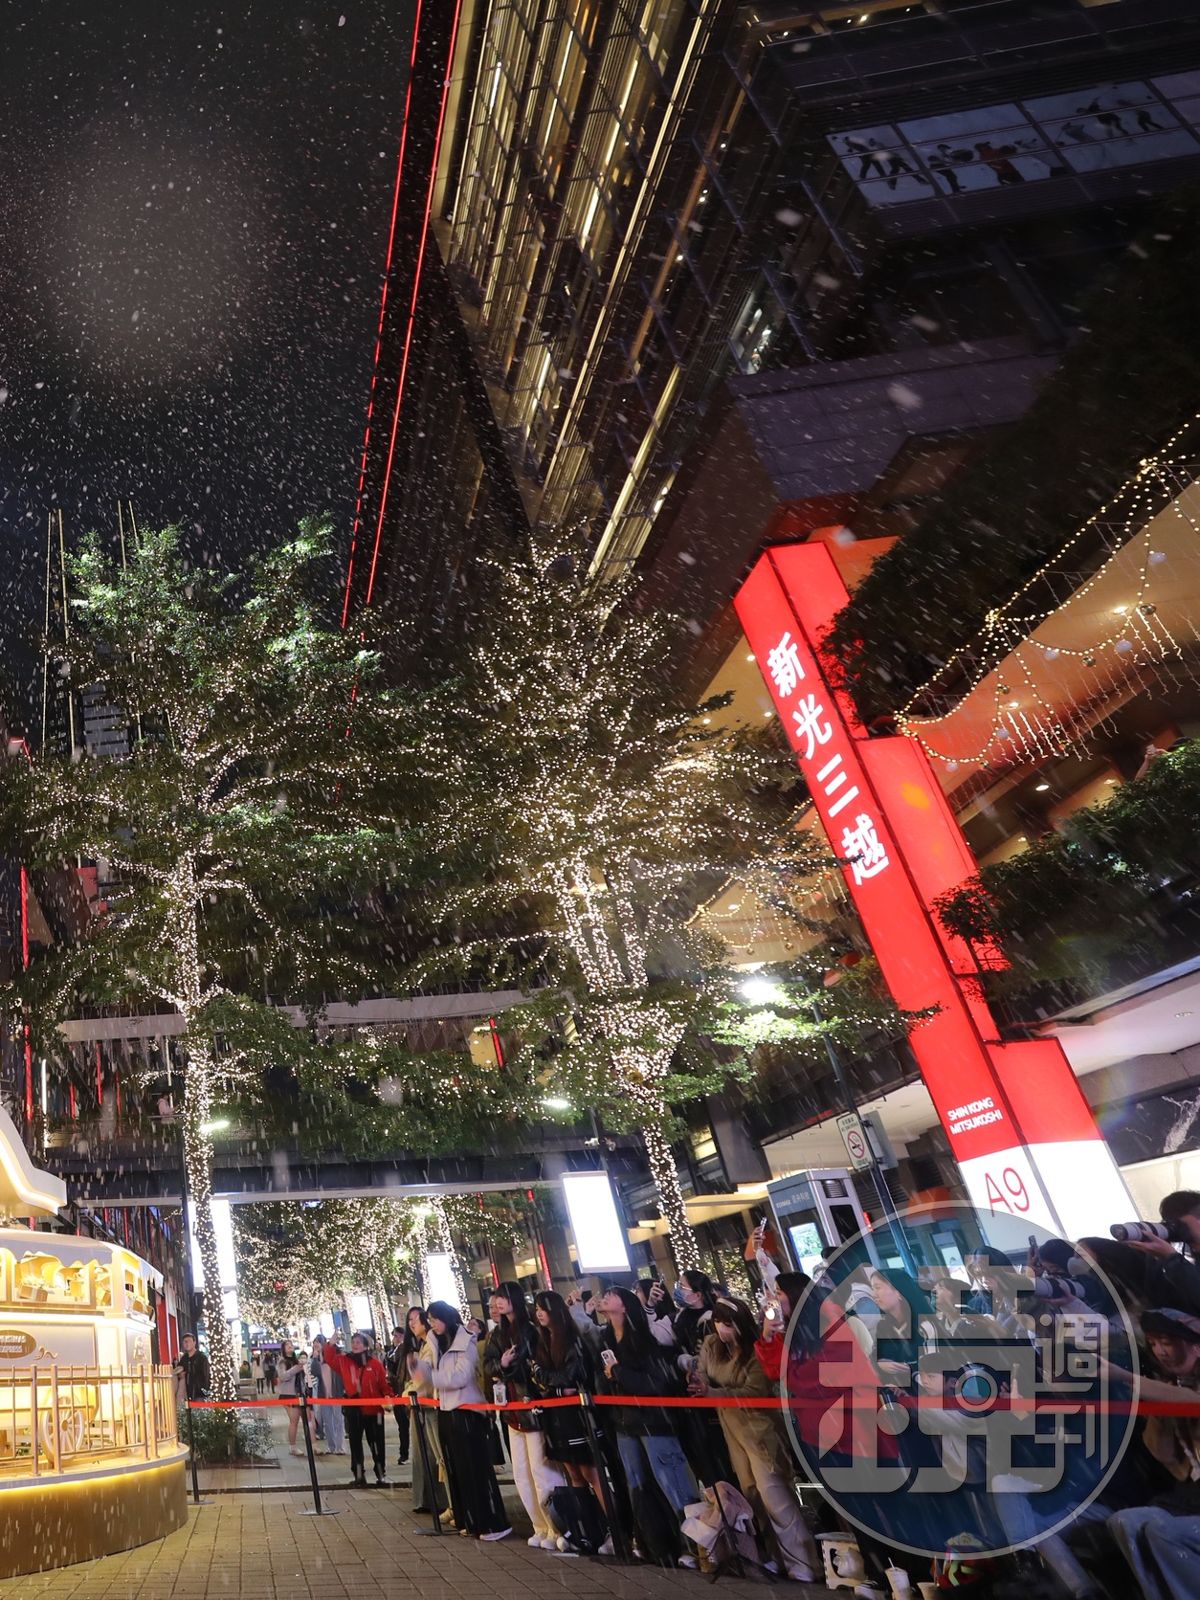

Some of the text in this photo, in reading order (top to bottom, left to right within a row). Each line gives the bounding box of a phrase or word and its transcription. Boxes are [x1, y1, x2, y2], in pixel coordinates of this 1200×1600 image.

[766, 631, 890, 886] 新光三越
[947, 1097, 995, 1121] SHIN KONG
[949, 1109, 1003, 1135] MITSUKOSHI
[984, 1167, 1030, 1217] A9
